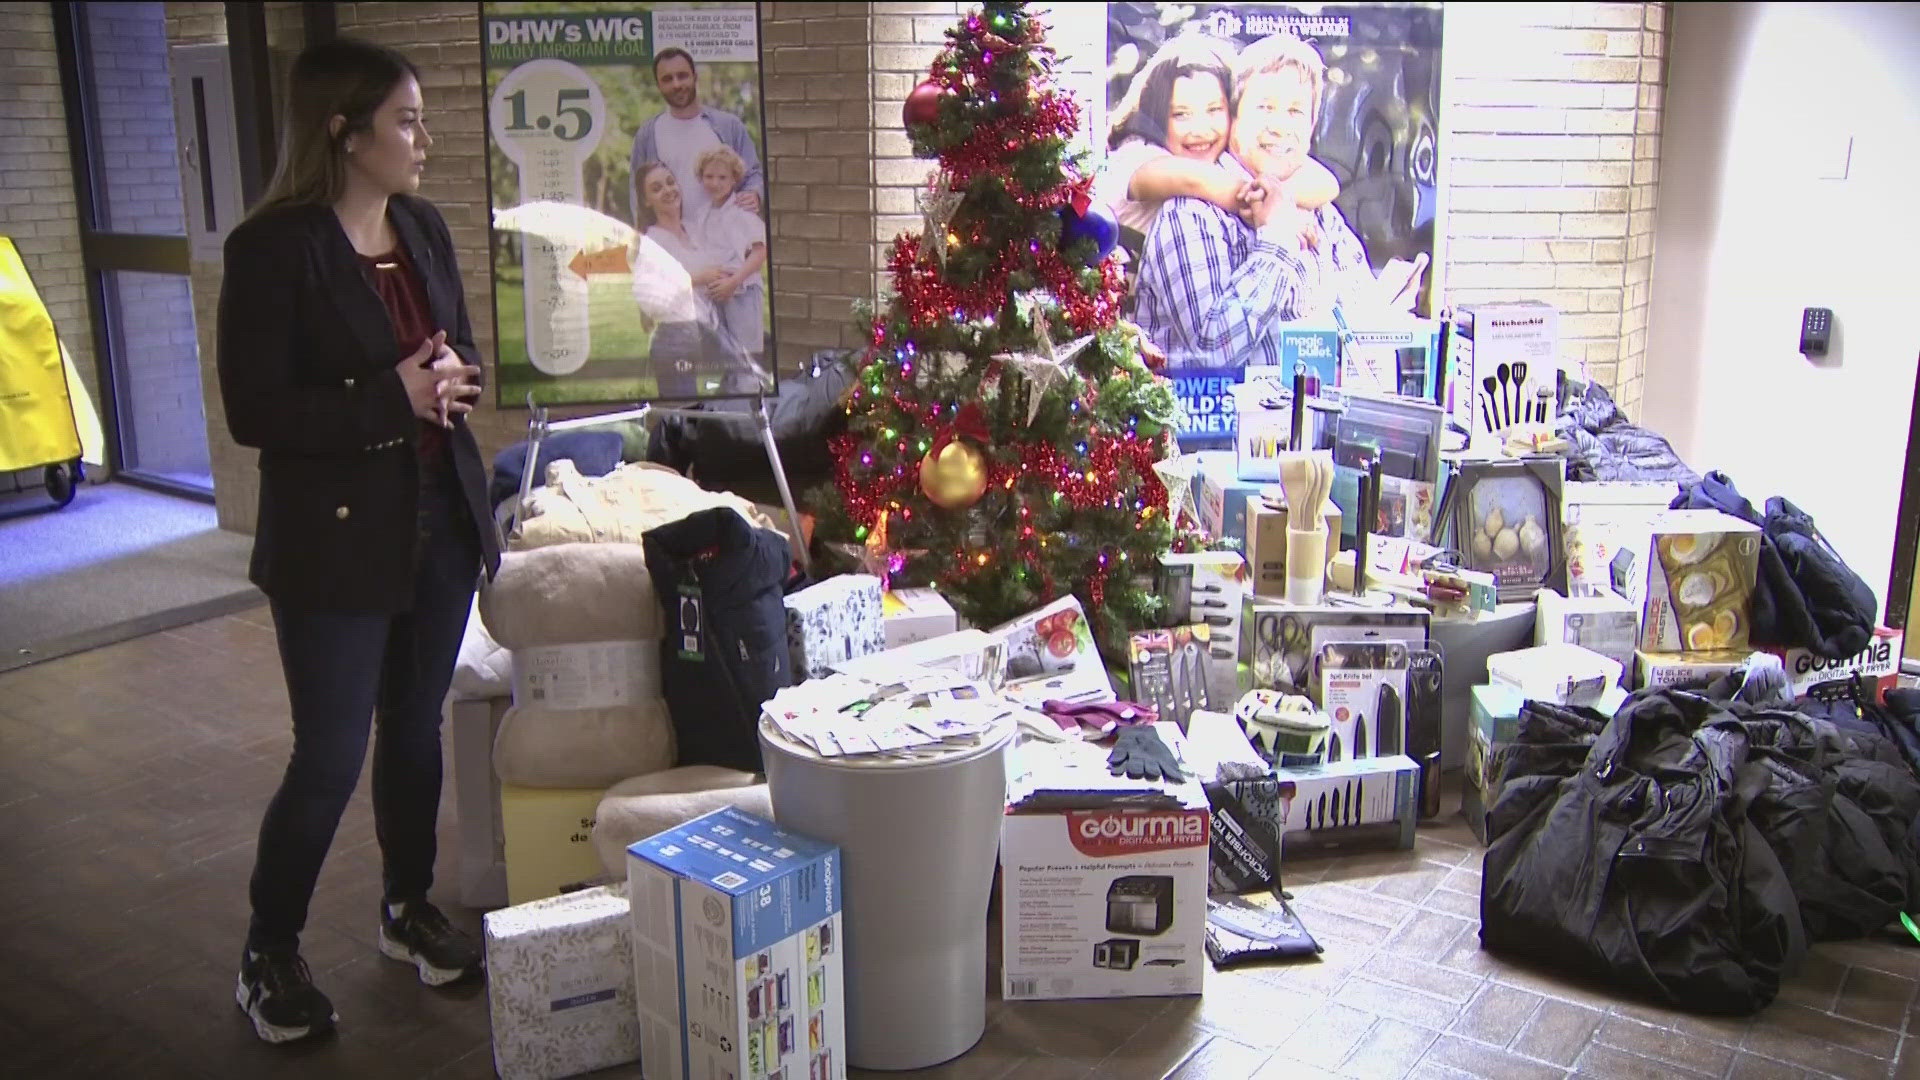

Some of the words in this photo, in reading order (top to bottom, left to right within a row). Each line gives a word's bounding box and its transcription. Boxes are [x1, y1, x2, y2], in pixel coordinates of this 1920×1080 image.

[488, 18, 582, 44] DHW's
[585, 17, 644, 42] WIG
[489, 43, 539, 60] WILDLY
[539, 41, 610, 59] IMPORTANT
[614, 39, 647, 57] GOAL
[503, 88, 593, 142] 1.5
[1491, 317, 1544, 328] KitchenAid
[1174, 376, 1236, 396] OWER
[1179, 394, 1235, 415] ILD'S
[1361, 672, 1372, 680] Set
[1080, 814, 1203, 839] Gourmia
[1119, 836, 1154, 845] DIGITAL
[1156, 835, 1172, 844] AIR
[1173, 833, 1203, 843] FRYER
[760, 884, 772, 908] 38
